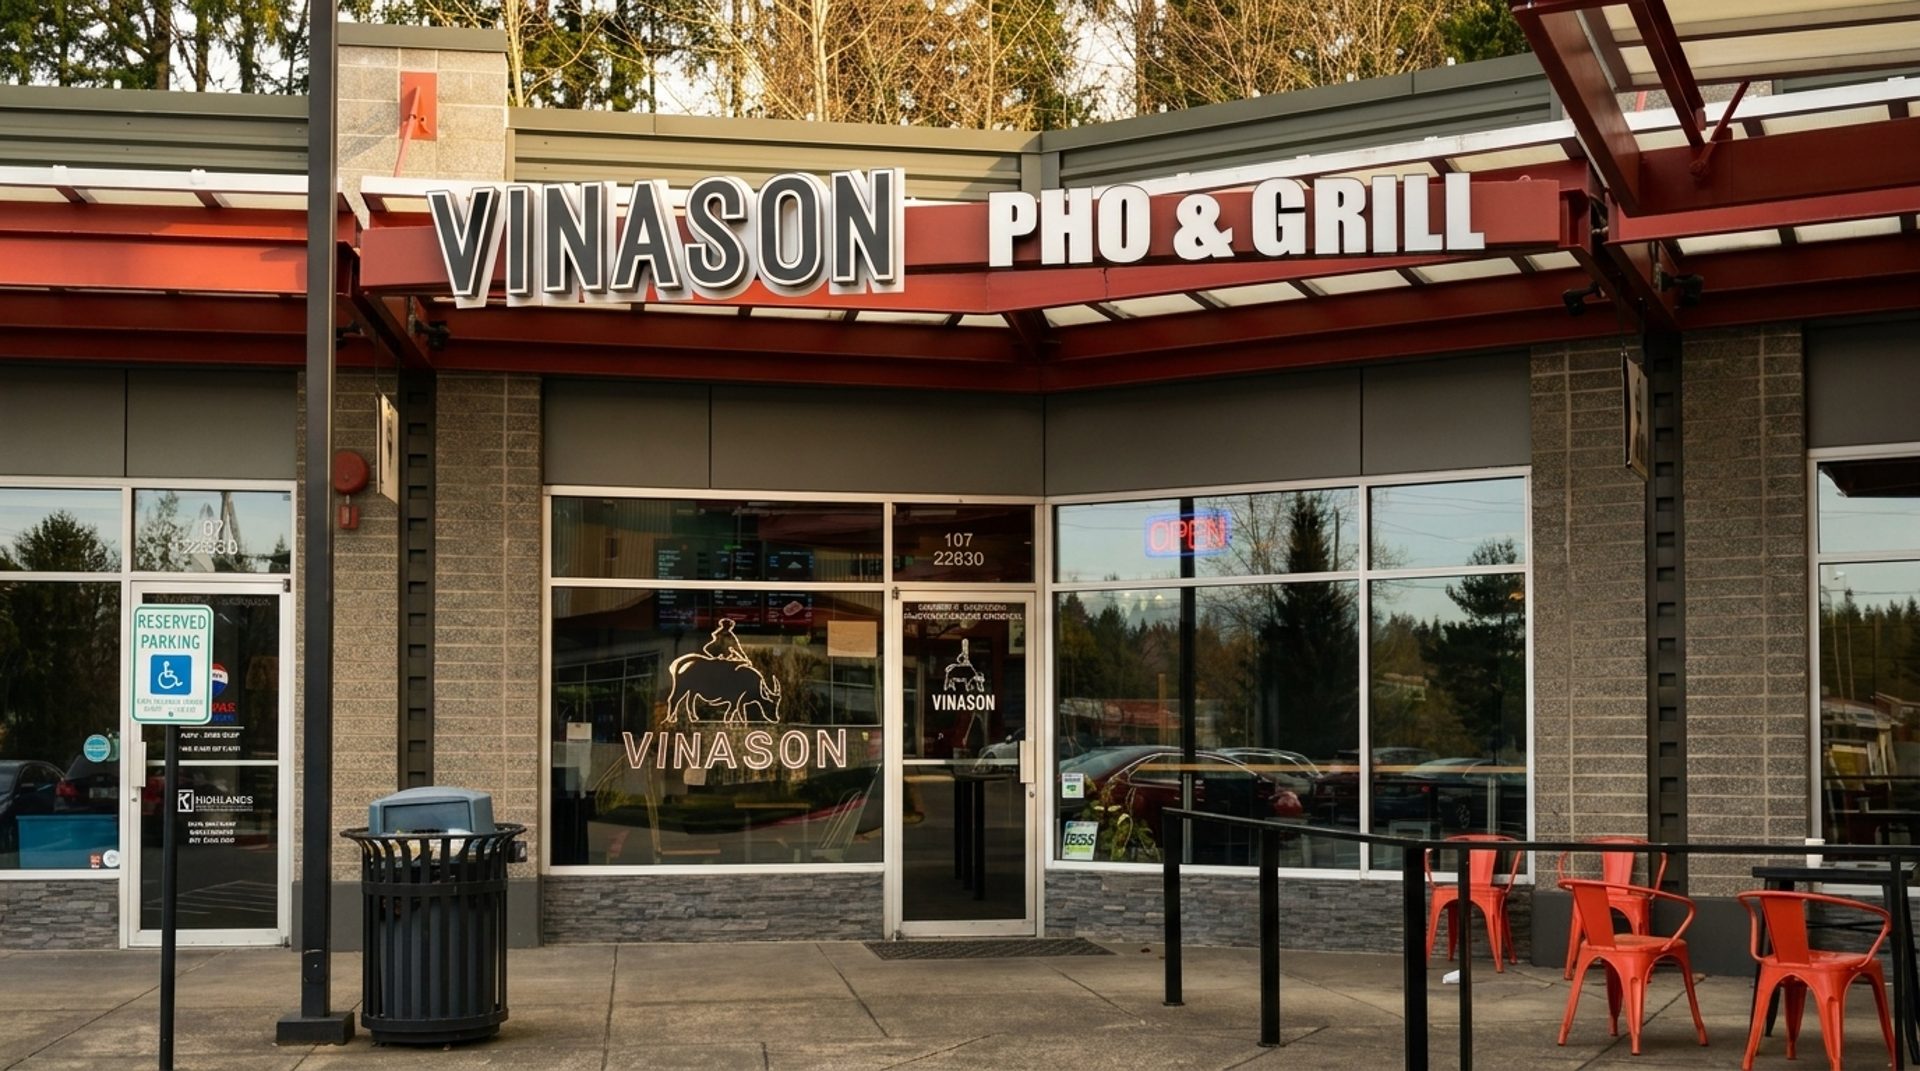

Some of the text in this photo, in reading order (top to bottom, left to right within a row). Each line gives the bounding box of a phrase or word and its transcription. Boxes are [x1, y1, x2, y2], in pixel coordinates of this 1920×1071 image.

[988, 172, 1485, 267] PHO & GRILL
[426, 167, 903, 305] VINASON
[944, 532, 973, 548] 107
[1150, 515, 1226, 553] OPEN
[933, 550, 985, 566] 22830
[137, 614, 207, 630] RESERVED
[141, 634, 201, 650] PARKING
[931, 694, 996, 711] VINASON
[622, 728, 848, 770] VINASON
